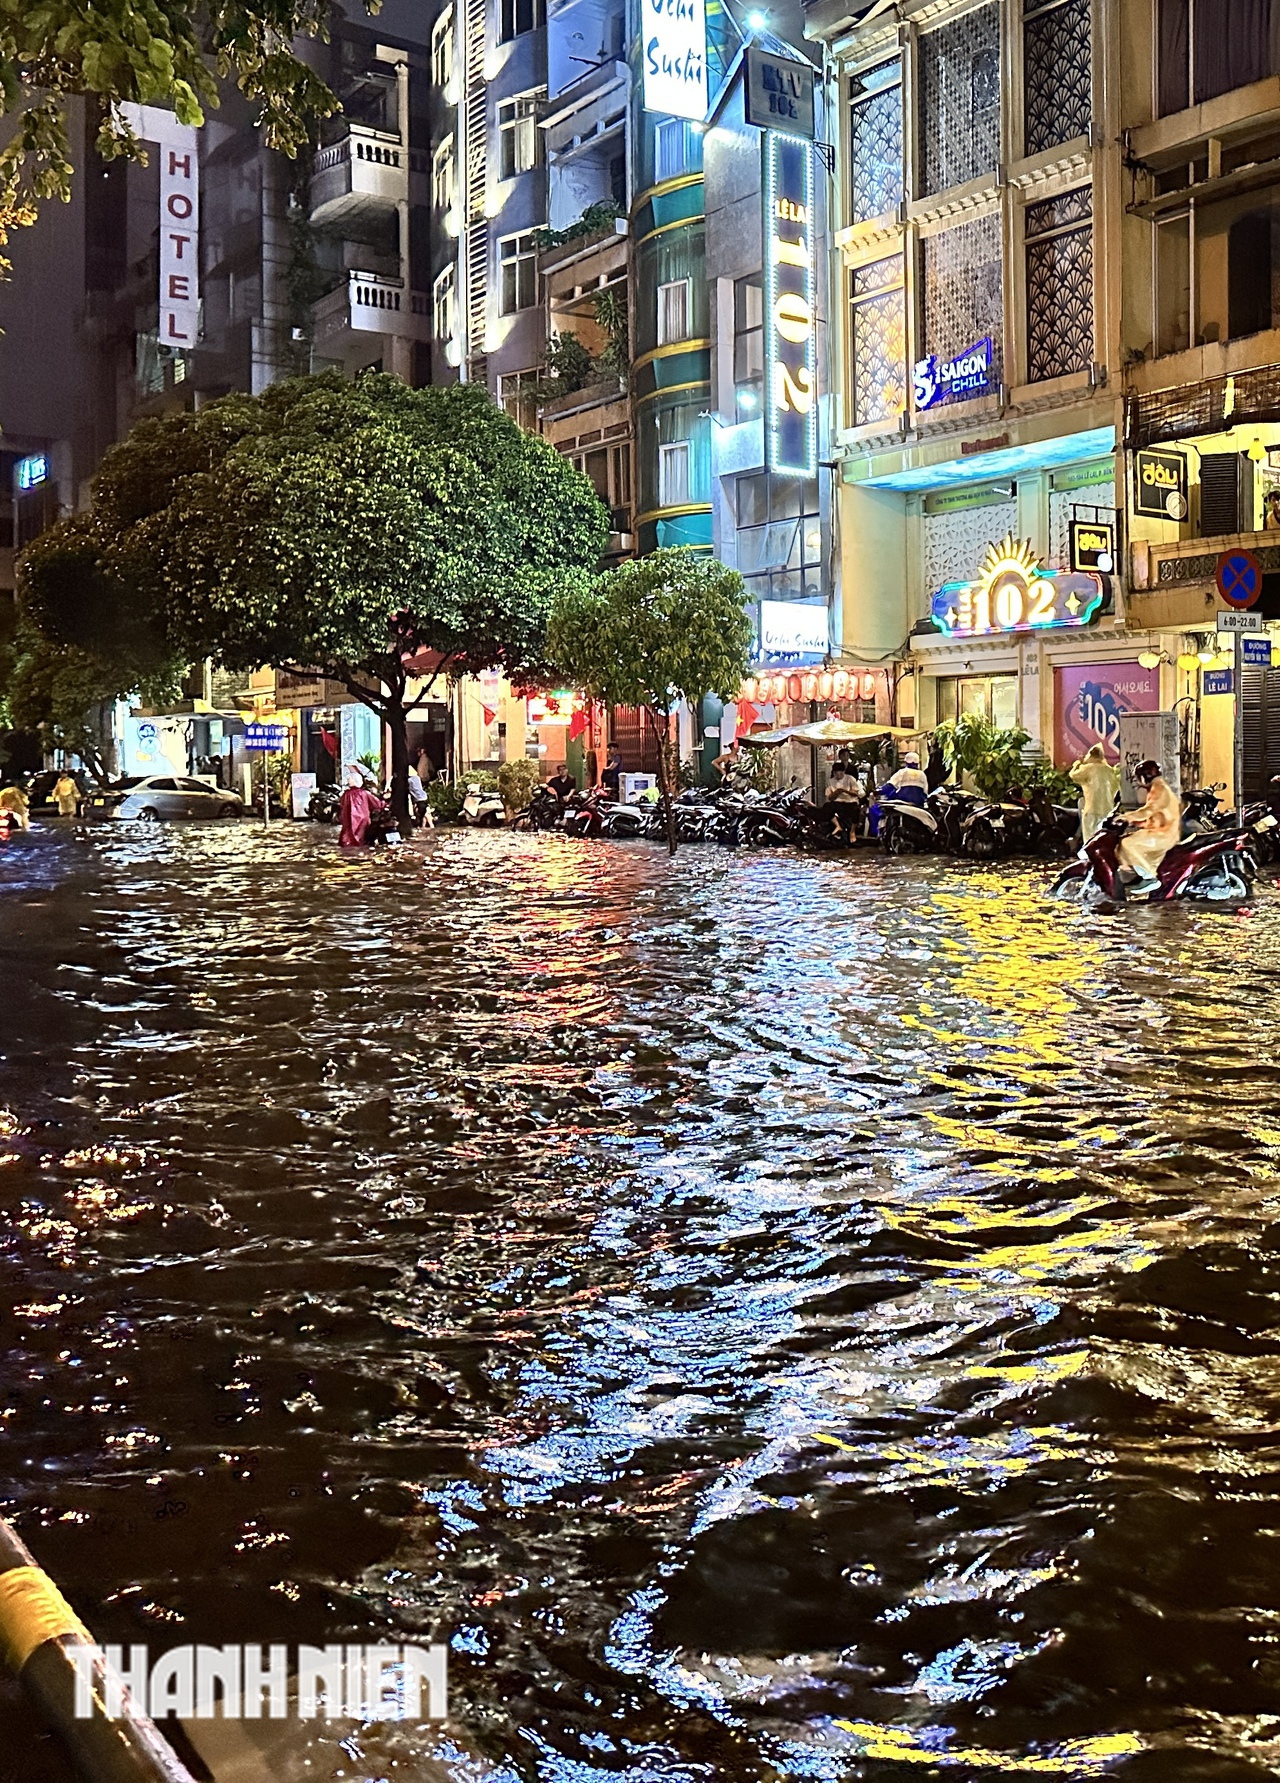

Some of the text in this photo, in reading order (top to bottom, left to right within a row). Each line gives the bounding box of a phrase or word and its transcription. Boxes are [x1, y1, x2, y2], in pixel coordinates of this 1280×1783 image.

[647, 36, 702, 84] Sushi
[167, 151, 193, 339] HOTEL
[941, 353, 987, 382] SAIGON
[952, 372, 988, 393] CHILL
[972, 580, 1056, 629] 102
[795, 633, 825, 648] Sushi
[1217, 682, 1228, 692] LAI
